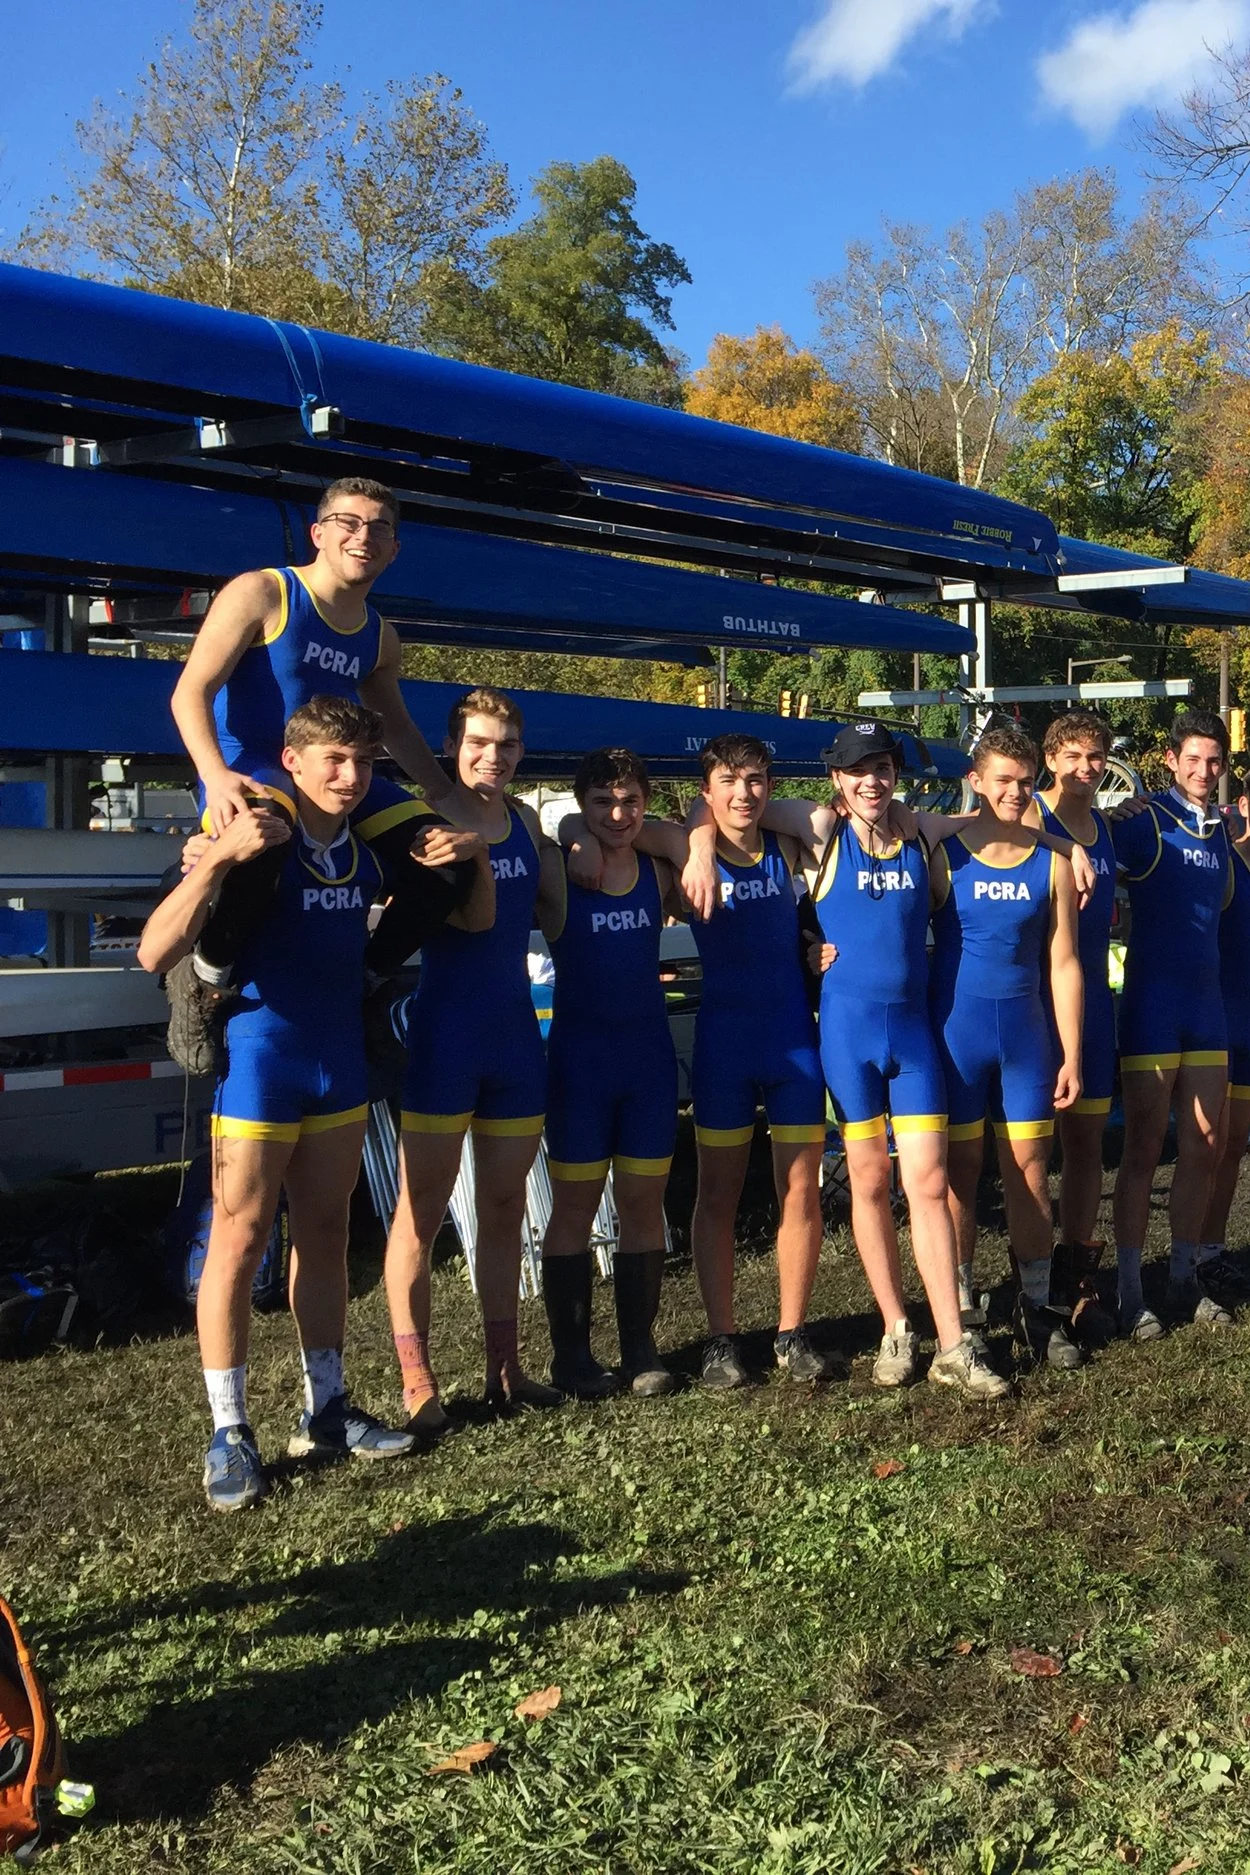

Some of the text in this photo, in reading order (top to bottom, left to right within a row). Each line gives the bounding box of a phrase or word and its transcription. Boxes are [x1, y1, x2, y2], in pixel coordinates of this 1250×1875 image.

[722, 615, 801, 637] BATHTUB
[302, 640, 360, 680] PCRA
[489, 856, 528, 881] CRA
[1090, 857, 1110, 875] RA
[1182, 847, 1220, 870] PCRA
[720, 877, 781, 903] PCRA
[857, 870, 915, 891] PCRA
[974, 881, 1031, 900] PCRA
[303, 886, 363, 911] PCRA
[592, 908, 651, 933] PCRA
